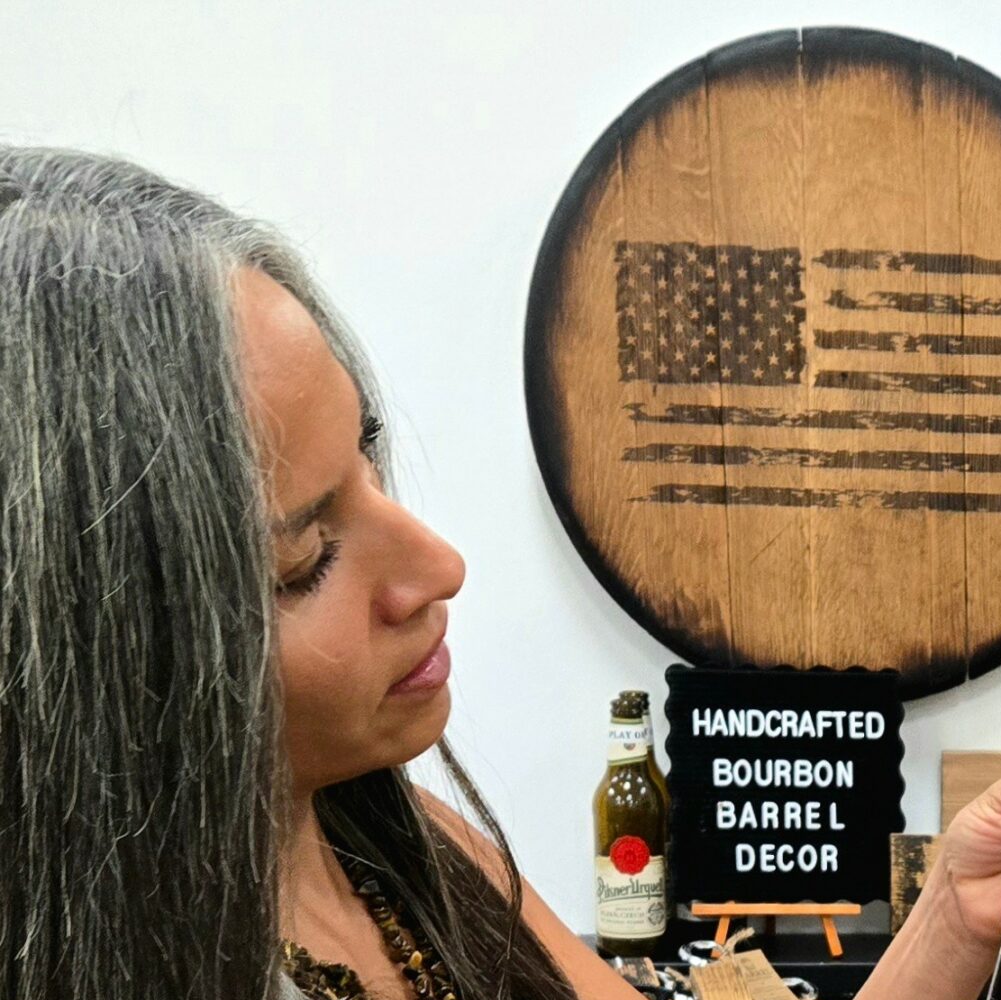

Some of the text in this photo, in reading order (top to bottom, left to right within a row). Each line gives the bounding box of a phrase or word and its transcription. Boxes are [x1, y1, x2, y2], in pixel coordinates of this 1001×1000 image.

[609, 730, 631, 739] PLAY
[692, 708, 885, 740] HANDCRAFTED
[712, 758, 854, 788] BOURBON
[716, 800, 846, 831] BARREL
[735, 843, 839, 873] DECOR
[596, 876, 630, 904] Pilsner
